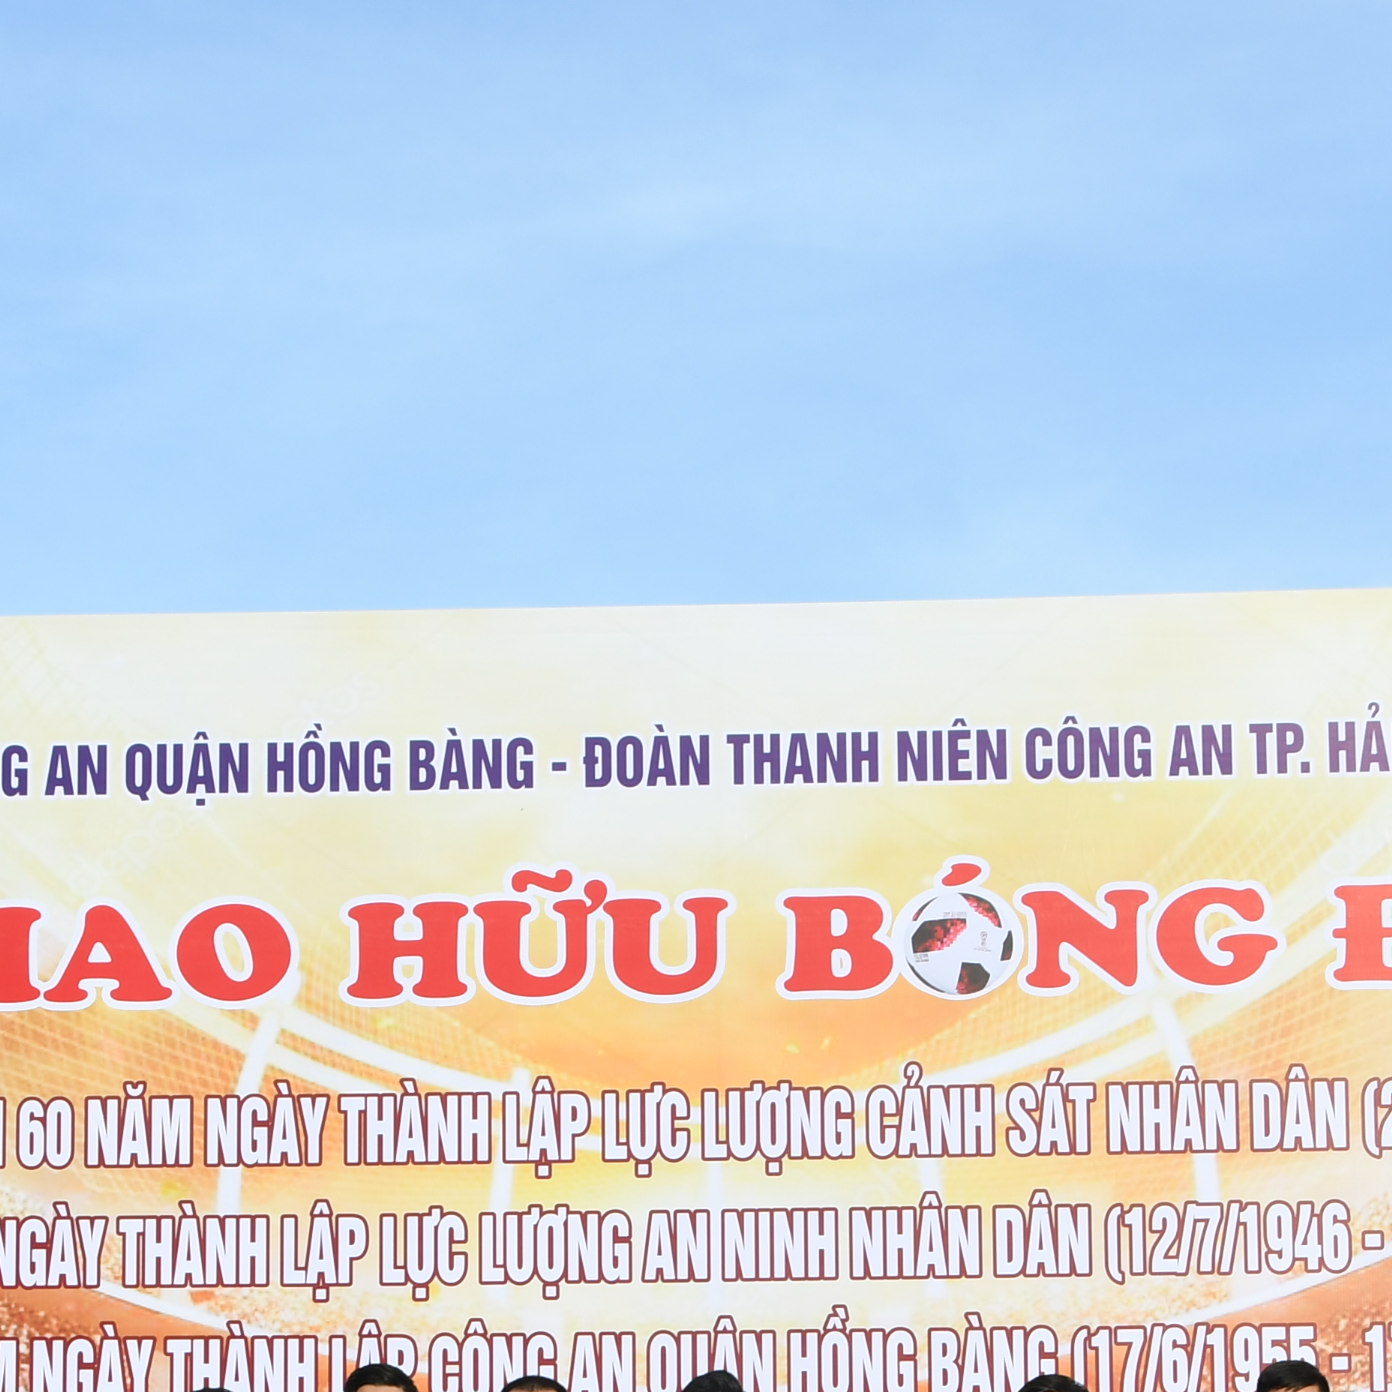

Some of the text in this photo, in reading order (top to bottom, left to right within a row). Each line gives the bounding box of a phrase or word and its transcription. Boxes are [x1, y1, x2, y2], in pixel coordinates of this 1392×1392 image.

[44, 743, 109, 797] AN
[123, 732, 250, 807] QUẬN
[266, 722, 392, 793] HỒNG
[408, 728, 535, 791] BÀNG
[581, 725, 711, 788] ĐOÀN
[725, 730, 880, 785] THANH
[896, 717, 1008, 782] NIÊN
[1024, 715, 1154, 780] CÔNG
[1169, 723, 1234, 778] AN
[1249, 722, 1311, 777] TP.
[347, 868, 729, 1000] HỮU
[18, 1099, 74, 1169] 60
[85, 1082, 191, 1168] NĂM
[205, 1080, 328, 1167] NGÀY
[341, 1079, 490, 1165] THÀNH
[503, 1077, 591, 1178] LẬP
[603, 1083, 690, 1177] LỰC
[702, 1082, 854, 1175] LƯỢNG
[865, 1062, 995, 1158] CẢNH
[1007, 1069, 1097, 1155] SÁT
[1106, 1065, 1238, 1154] NHÂN
[1250, 1065, 1348, 1152] DÂN
[119, 1201, 267, 1287] THÀNH
[279, 1200, 368, 1302] LẬP
[379, 1206, 467, 1300] LỰC
[479, 1204, 632, 1300] LƯỢNG
[642, 1209, 710, 1282] AN
[722, 1208, 838, 1281] NINH
[850, 1192, 982, 1279] NHÂN
[992, 1189, 1092, 1277] DÂN
[1107, 1199, 1353, 1284] (12/7/1946
